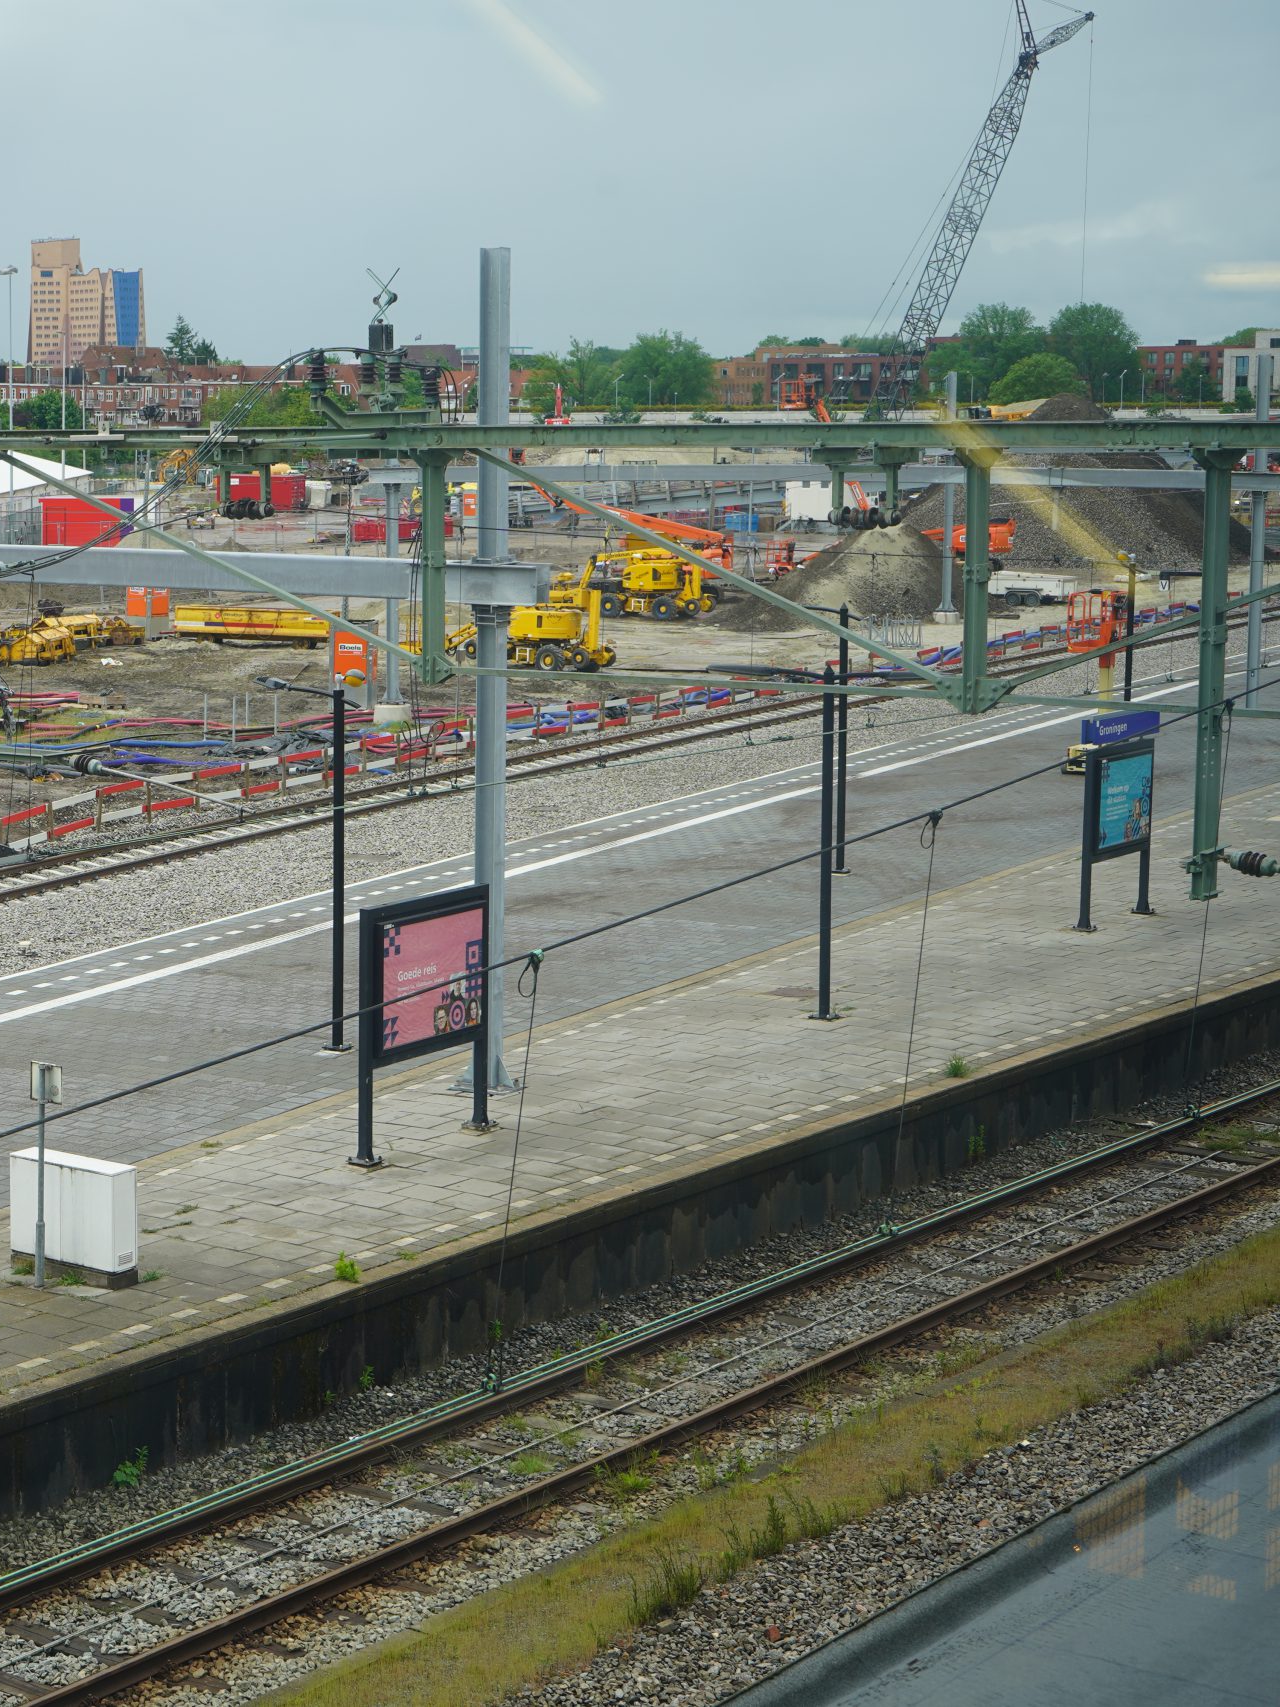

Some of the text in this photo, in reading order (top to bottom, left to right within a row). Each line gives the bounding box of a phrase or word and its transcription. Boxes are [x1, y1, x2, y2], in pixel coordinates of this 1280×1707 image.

[1160, 580, 1168, 590] V
[1099, 722, 1128, 736] Groningen
[397, 962, 437, 982] Goede reis
